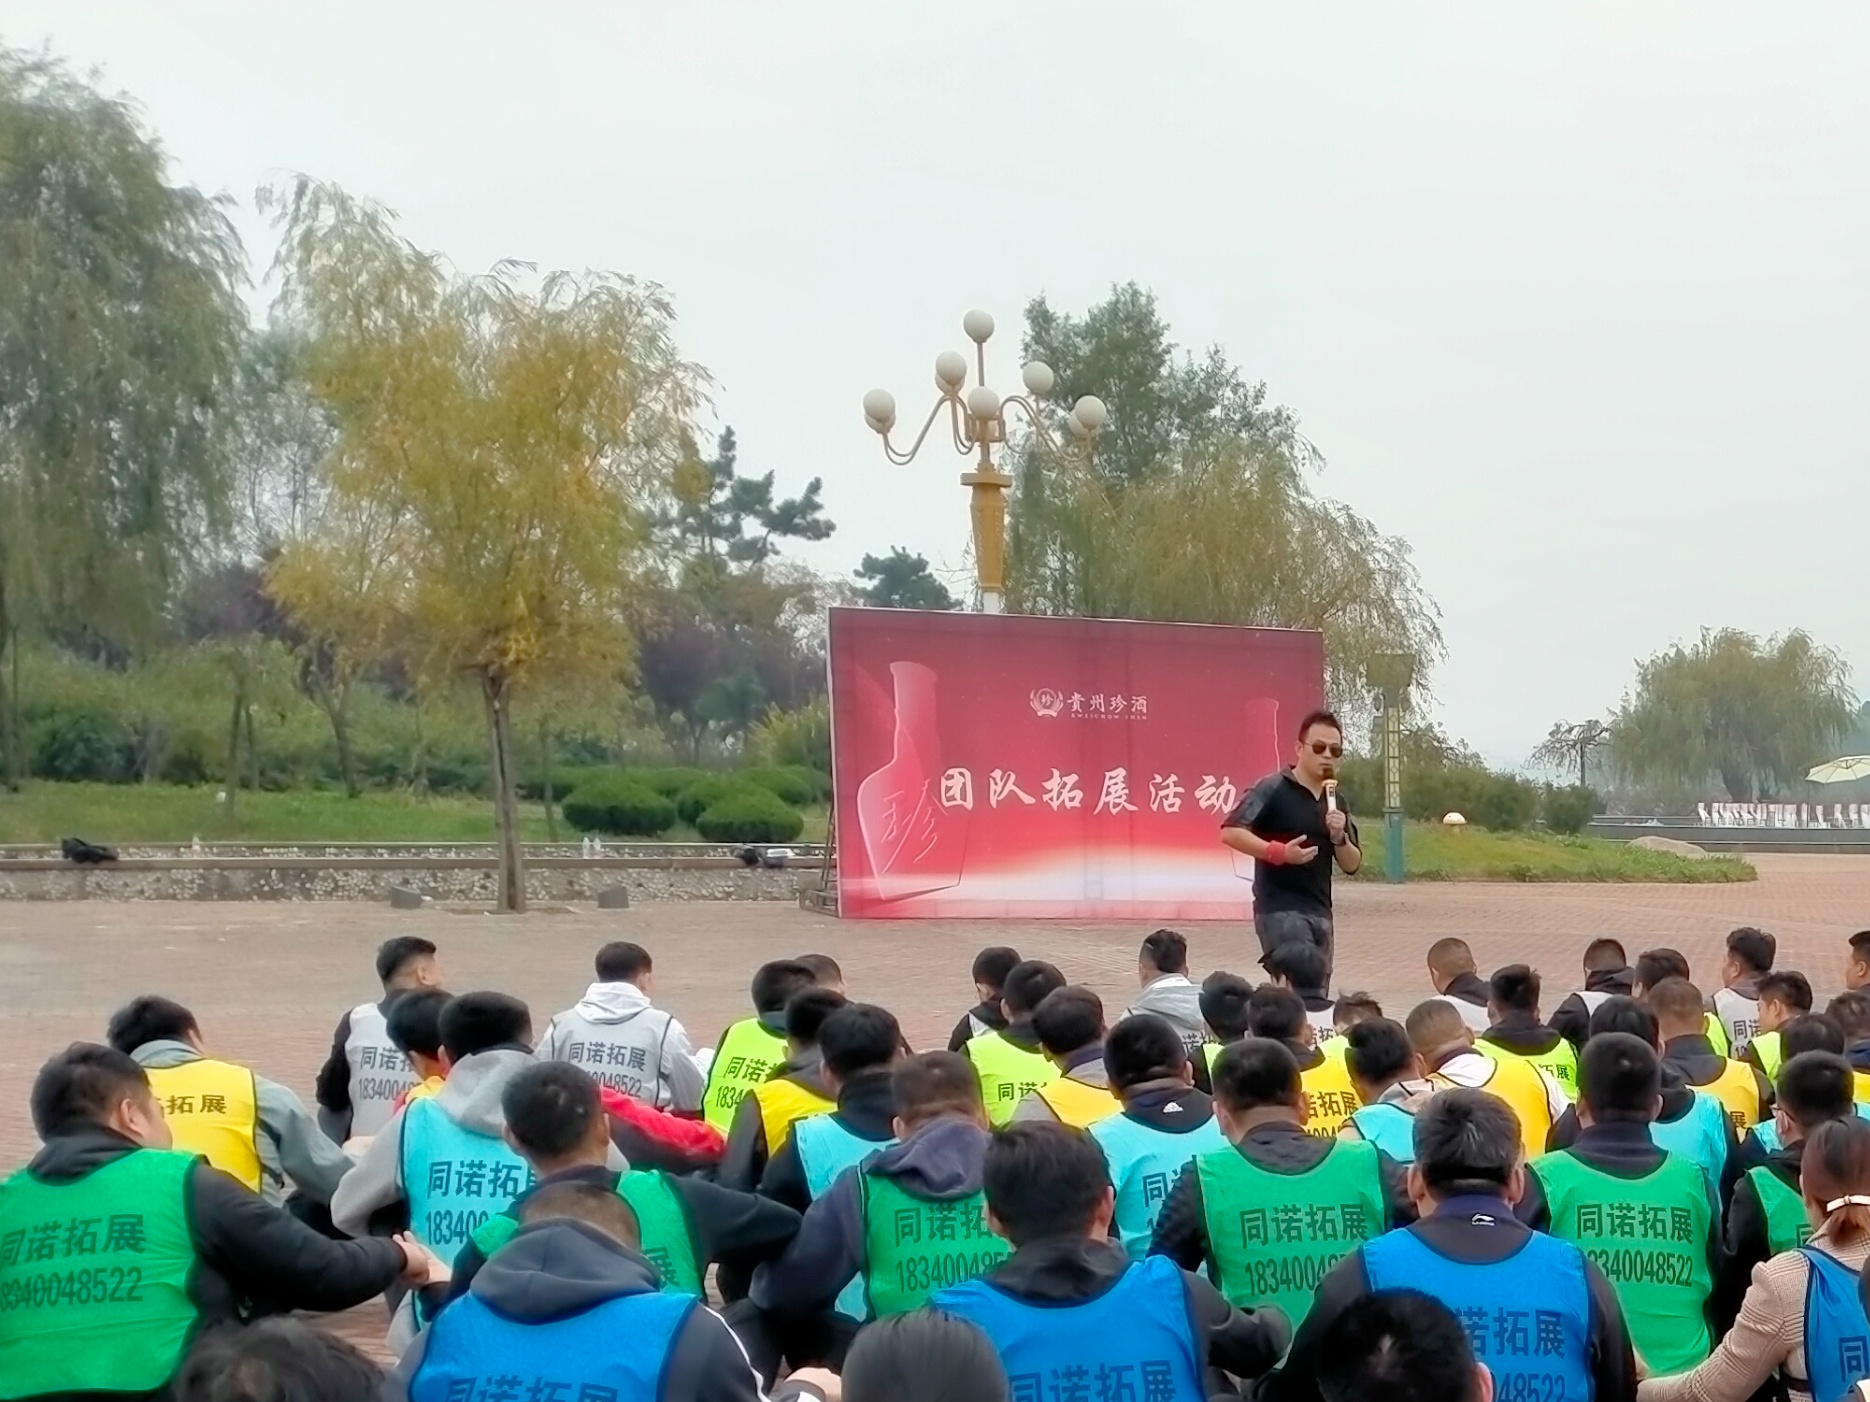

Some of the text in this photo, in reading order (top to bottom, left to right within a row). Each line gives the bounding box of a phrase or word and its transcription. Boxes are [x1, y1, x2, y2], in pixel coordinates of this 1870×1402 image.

[940, 767, 1238, 815] 团队拓展活动
[568, 1042, 646, 1072] 同诺拓展
[155, 1094, 229, 1114] 拓展
[998, 1082, 1047, 1101] 同诺
[0, 1213, 147, 1270] 同诺拓展
[1240, 1203, 1369, 1249] 同诺拓展
[1577, 1203, 1693, 1244] 同诺拓展
